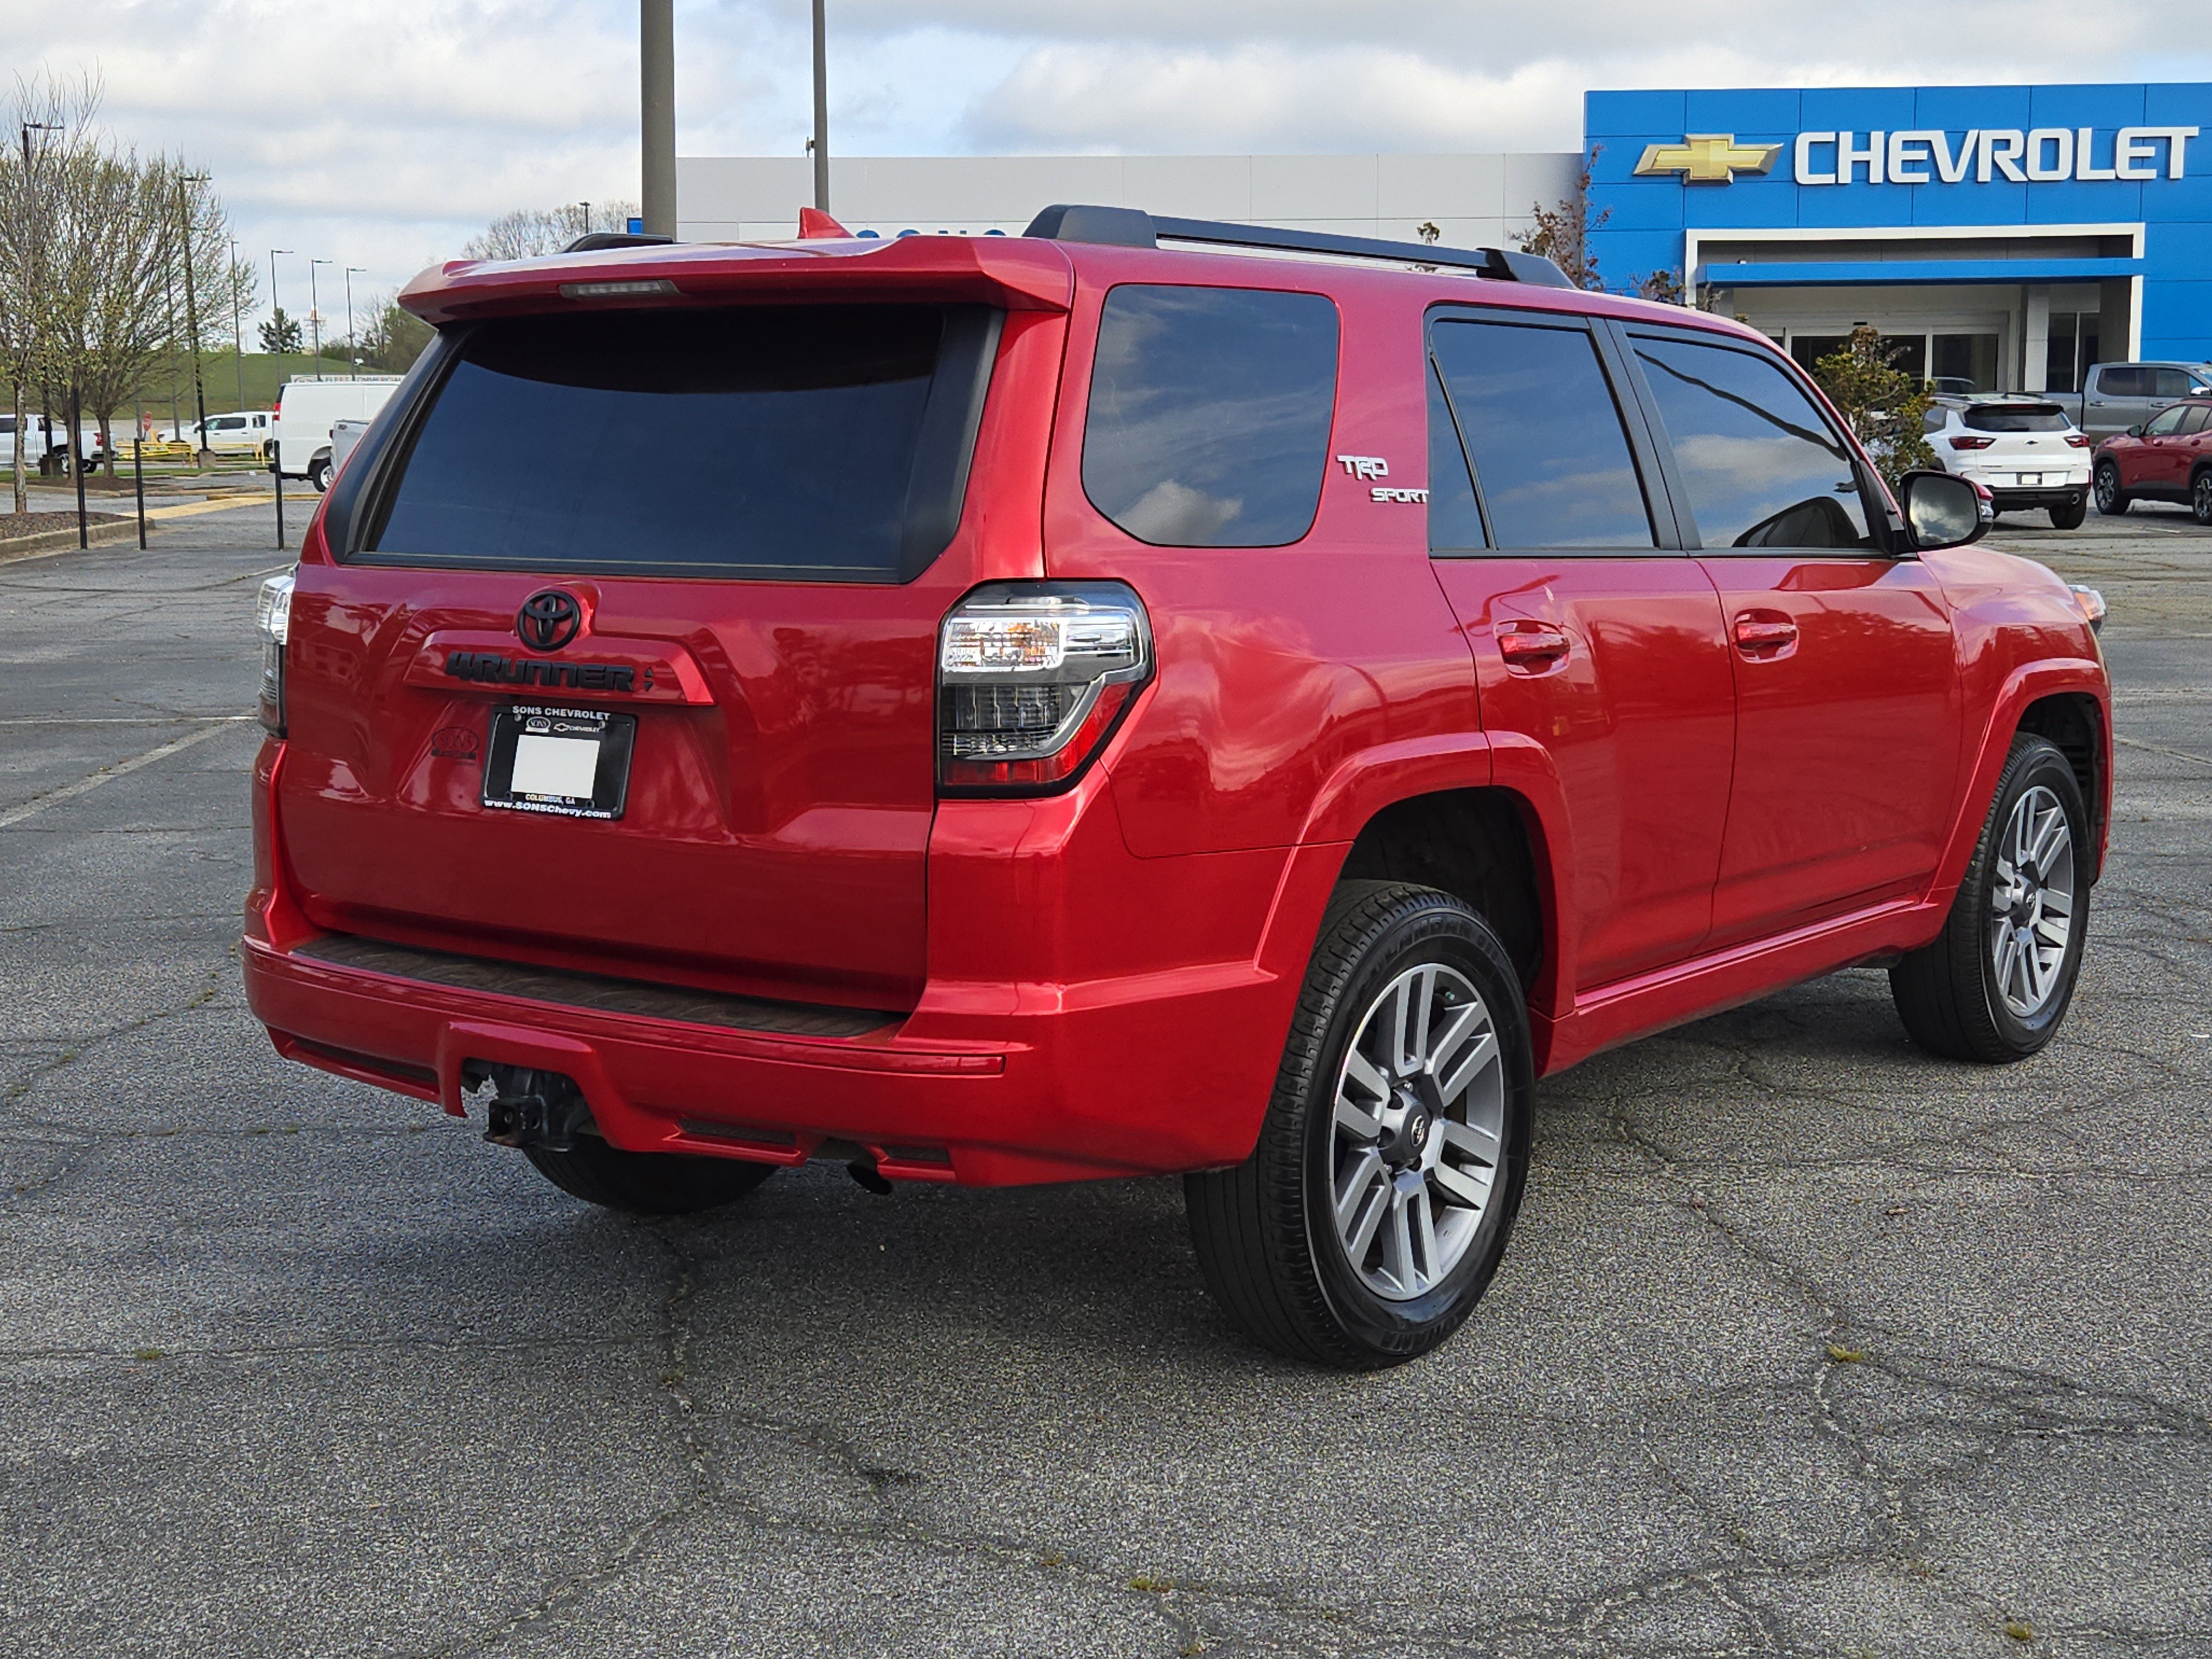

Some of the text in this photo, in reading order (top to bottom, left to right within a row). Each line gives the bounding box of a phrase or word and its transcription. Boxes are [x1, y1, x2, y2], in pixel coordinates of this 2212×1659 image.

[1795, 127, 2199, 185] CHEVROLET
[1336, 455, 1388, 480] TRD
[1370, 487, 1429, 503] SPORT
[446, 652, 635, 692] 4RUNNER
[512, 706, 610, 721] SONS CHEVROLET
[484, 800, 612, 819] www.SONSChevy.com
